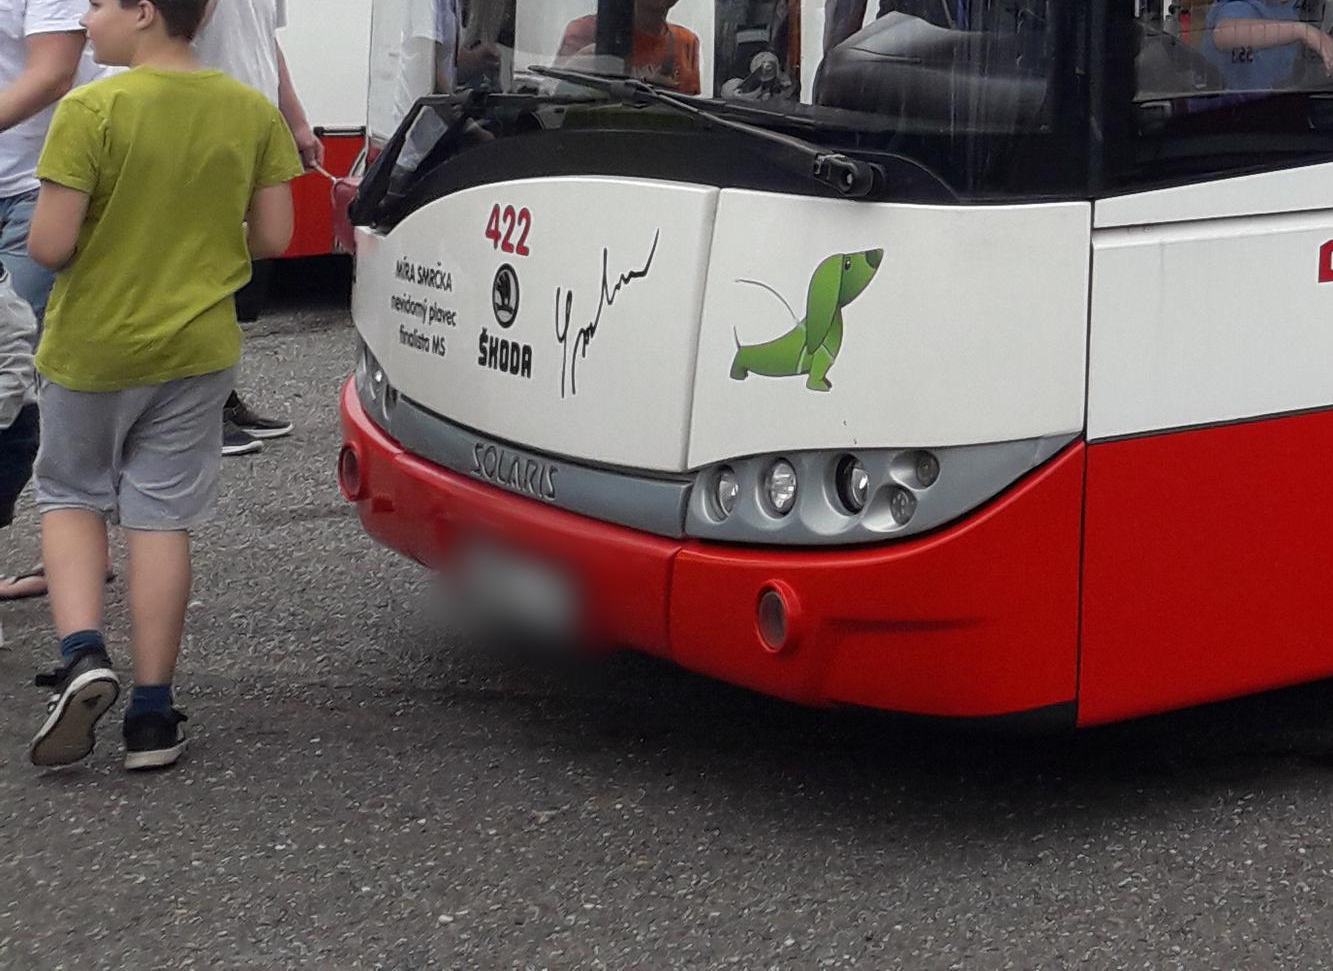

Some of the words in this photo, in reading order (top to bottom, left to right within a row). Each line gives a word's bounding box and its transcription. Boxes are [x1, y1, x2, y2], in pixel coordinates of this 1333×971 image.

[485, 203, 531, 256] 422
[417, 261, 453, 293] SMRČKA
[428, 301, 457, 327] plavec
[431, 334, 447, 357] MS
[478, 328, 532, 379] ŠKODA
[470, 442, 559, 501] SOLARIS
